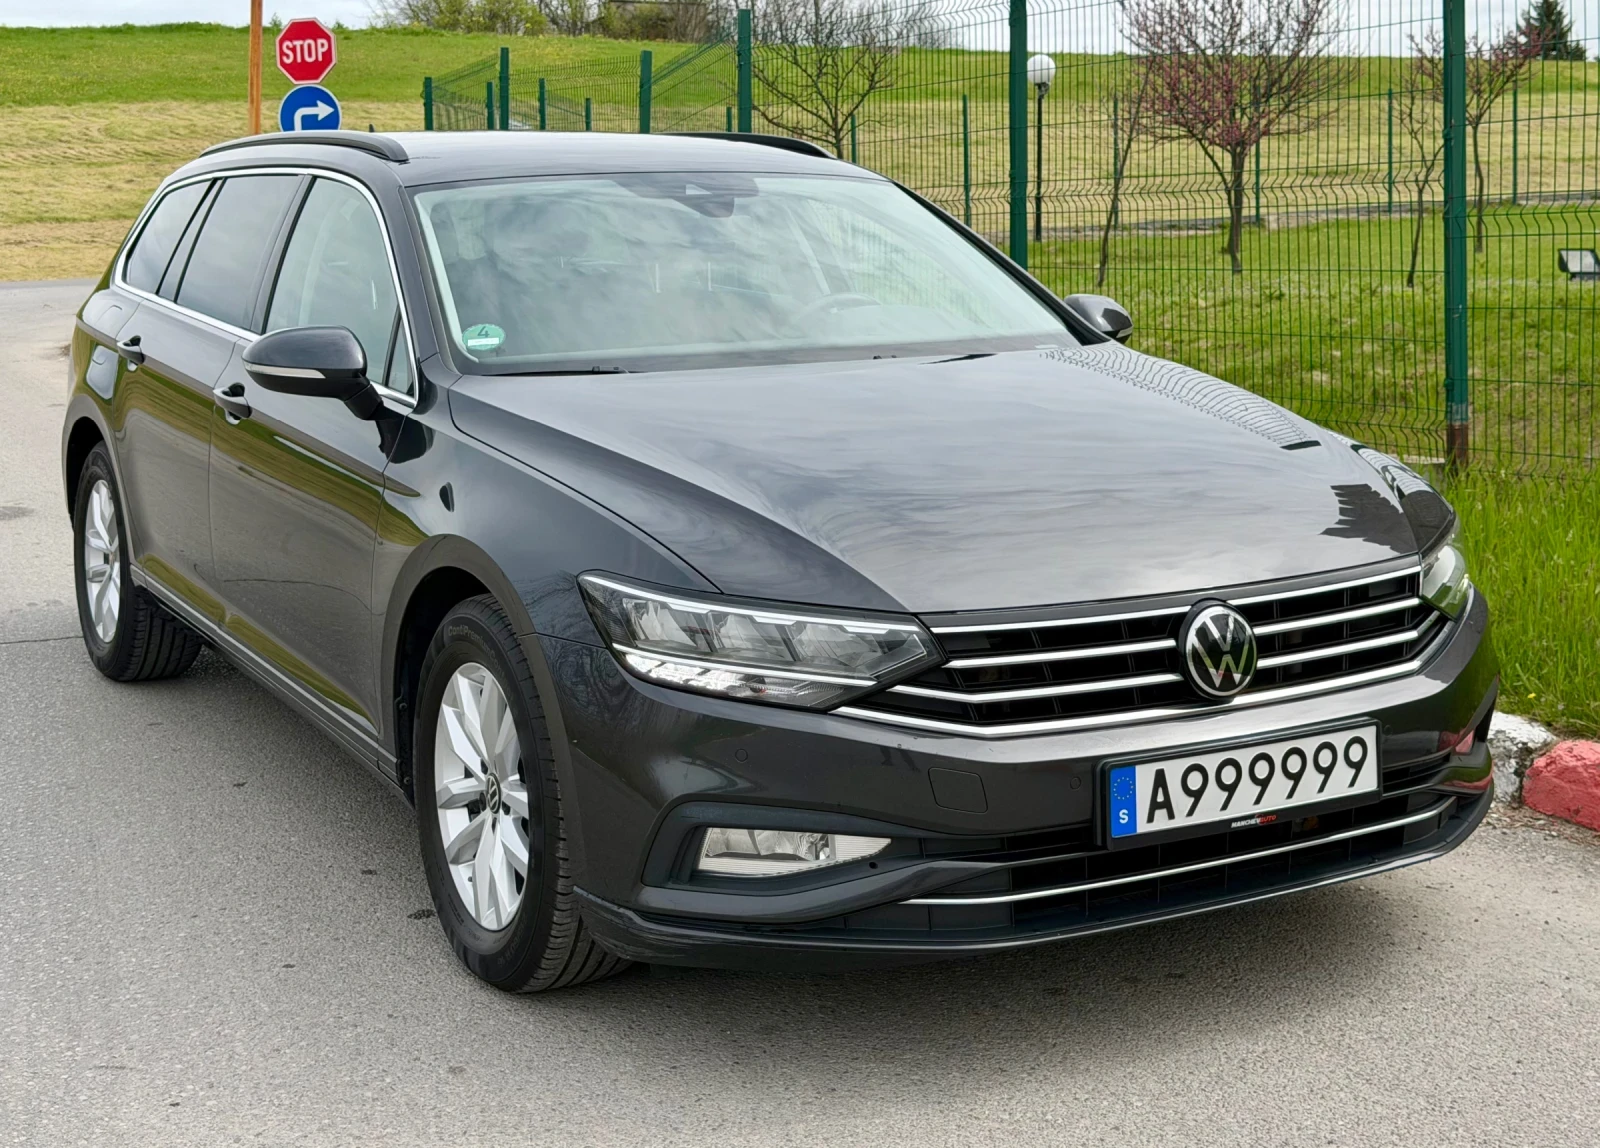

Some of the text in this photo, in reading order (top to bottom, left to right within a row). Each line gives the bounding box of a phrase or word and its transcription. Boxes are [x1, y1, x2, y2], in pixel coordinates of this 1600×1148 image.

[282, 38, 329, 64] STOP
[477, 325, 490, 338] 4
[1189, 609, 1254, 692] VW
[1146, 735, 1368, 824] A999999
[1119, 809, 1129, 824] S
